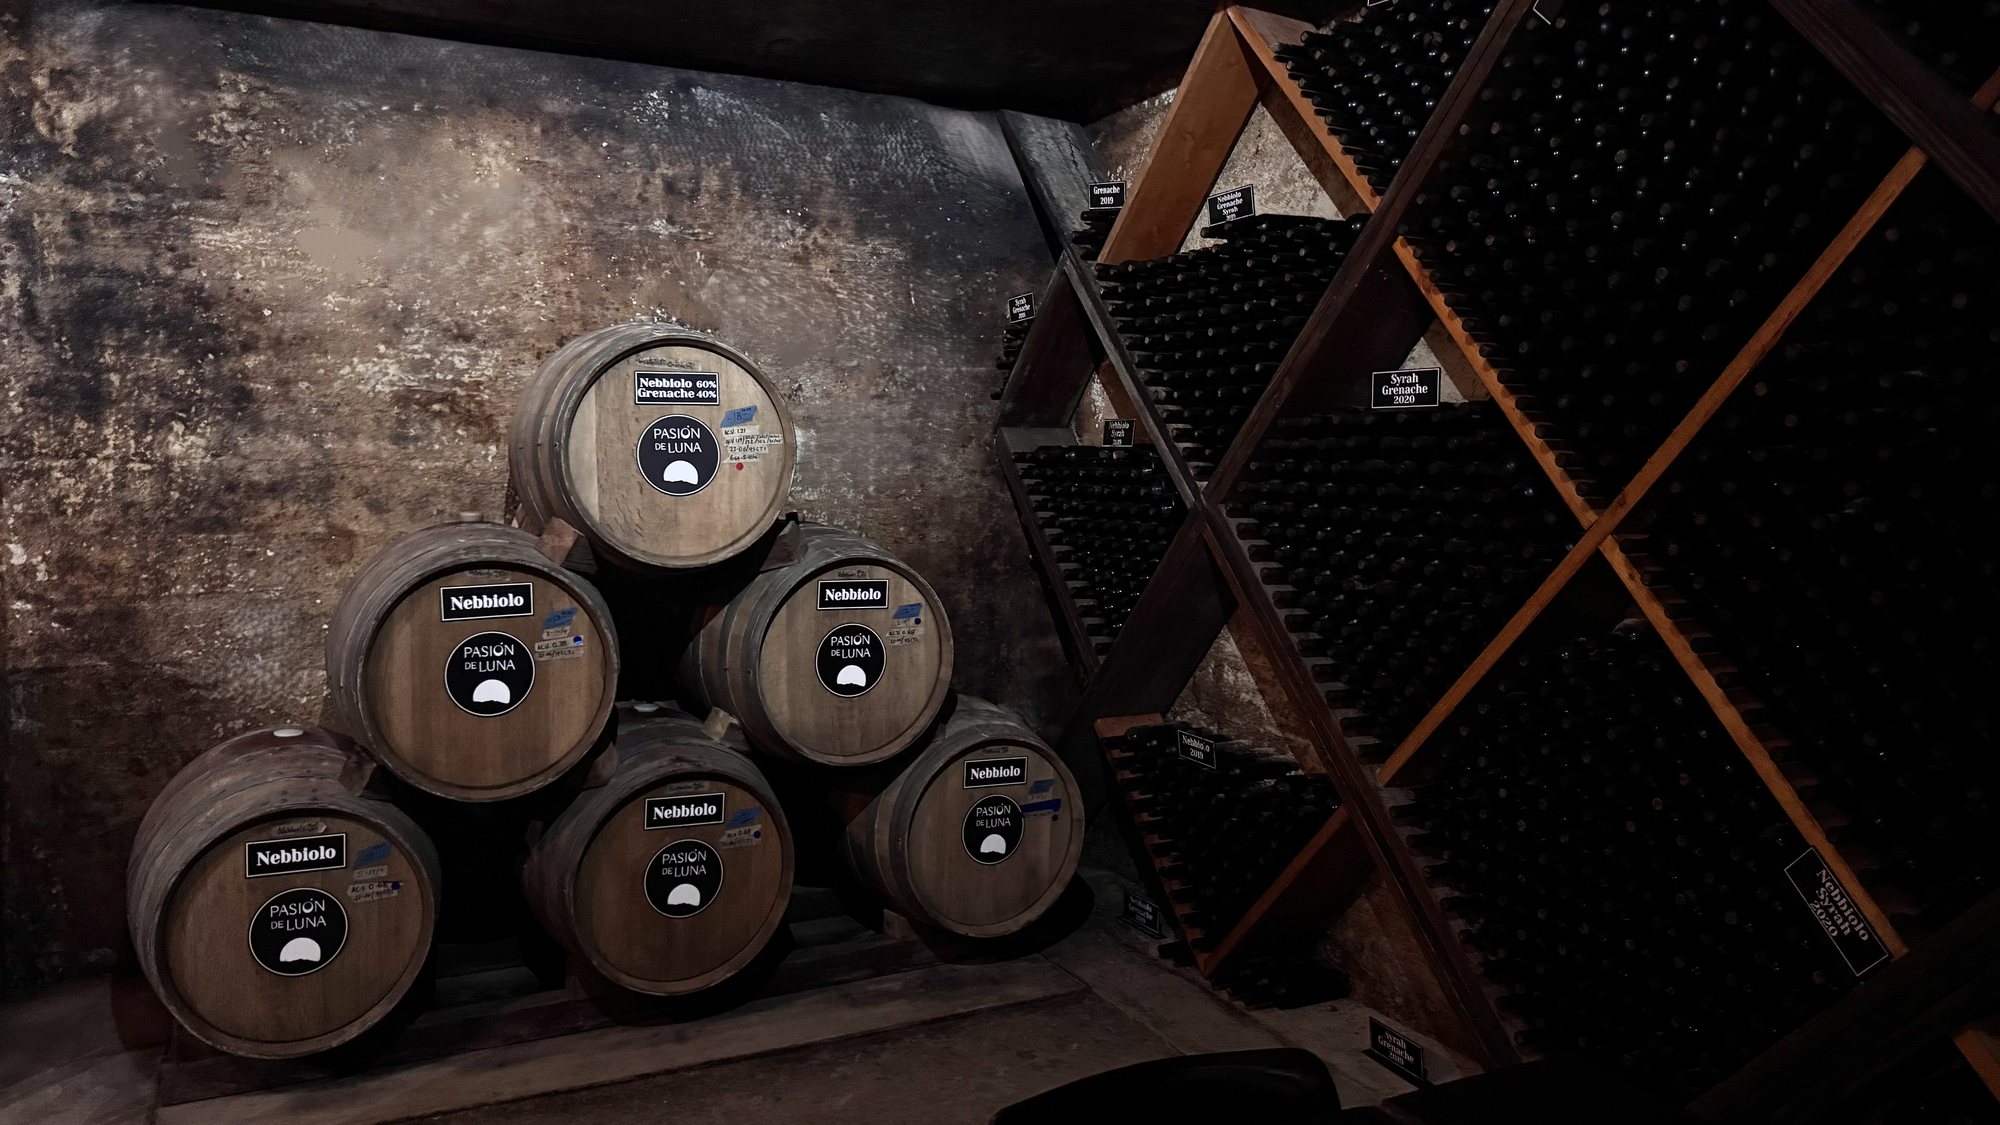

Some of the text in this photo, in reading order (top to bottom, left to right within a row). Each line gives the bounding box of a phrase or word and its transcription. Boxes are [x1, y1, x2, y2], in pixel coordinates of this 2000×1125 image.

[1093, 185, 1120, 194] Grenache
[1100, 196, 1114, 205] 2019
[1216, 198, 1243, 210] Grenache
[1217, 191, 1242, 203] Nebbiolo
[1222, 206, 1239, 216] Syrah
[639, 377, 717, 389] Nebbiolo 60%
[1390, 373, 1419, 386] Syrah
[637, 388, 717, 399] Grenache 40%
[1382, 384, 1428, 396] Grenache
[1393, 395, 1416, 405] 2020
[653, 425, 701, 440] PASIÓN
[654, 442, 703, 454] DE LUNA
[450, 592, 525, 611] Nebbiolo
[824, 588, 882, 601] Nebbiolo
[830, 632, 871, 647] PASIÓN
[463, 641, 515, 659] PASIÓN
[830, 648, 872, 659] DE LUNA
[464, 660, 516, 673] DE LUNA
[1182, 734, 1210, 753] Nebbioo
[970, 765, 1021, 780] Nebbiolo
[652, 803, 717, 820] Nebbiolo
[976, 803, 1011, 818] PASIÓN
[976, 817, 1011, 829] DE LUNA
[256, 845, 337, 867] Nebbiolo
[662, 848, 707, 865] PASIÓN
[662, 865, 707, 878] DE LUNA
[270, 897, 326, 918] PASIÓN
[1815, 869, 1869, 941] Nebbiolo
[1815, 887, 1851, 936] Syrah
[270, 915, 327, 932] DE LUNA
[1809, 900, 1838, 937] 2020
[1377, 1034, 1415, 1064] Grenache
